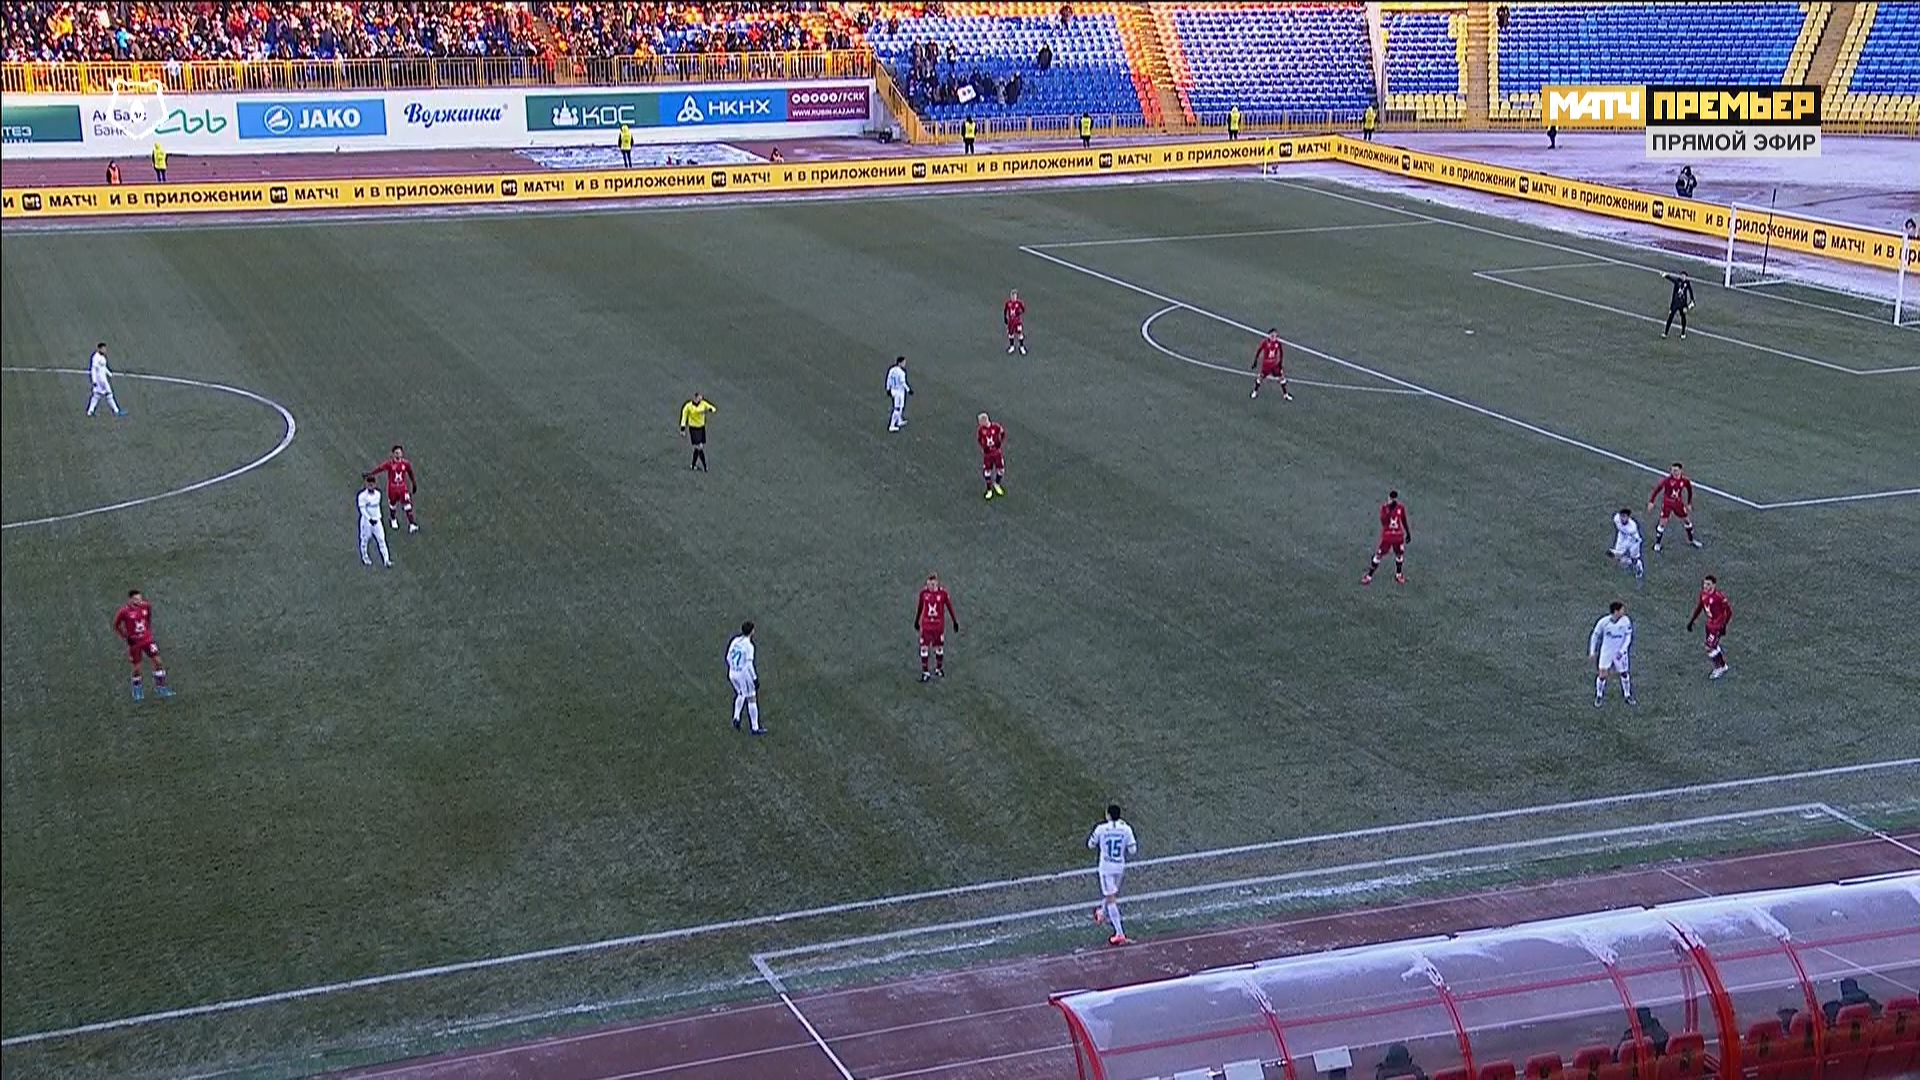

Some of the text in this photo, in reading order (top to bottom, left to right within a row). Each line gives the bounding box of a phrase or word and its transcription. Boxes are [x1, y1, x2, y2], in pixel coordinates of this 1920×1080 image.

[404, 103, 501, 128] Волжанка
[582, 105, 636, 125] КОС
[708, 99, 771, 117] НКНХ
[298, 109, 361, 129] JAKO
[49, 195, 97, 207] МАТЧ!
[110, 194, 120, 205] и
[127, 193, 138, 204] в
[144, 190, 262, 207] приложении
[295, 187, 339, 199] МАТЧ!
[354, 187, 365, 198] и
[371, 187, 380, 198] в
[386, 183, 495, 203] приложении
[523, 180, 564, 192] МАТЧ!
[575, 180, 584, 191] и
[590, 179, 599, 190] в
[605, 174, 704, 193] приложении
[733, 172, 771, 184] МАТЧ!
[784, 171, 792, 181] и
[798, 171, 806, 180] в
[812, 166, 906, 182] приложении
[932, 163, 968, 175] МАТЧ!
[977, 162, 986, 172] и
[990, 161, 998, 171] в
[1003, 157, 1093, 175] приложении
[1118, 153, 1152, 165] МАТЧ!
[1163, 153, 1172, 163] и
[1176, 152, 1184, 162] в
[1297, 142, 1331, 154] МАТЧ!
[1350, 146, 1399, 166] приложении
[1413, 160, 1435, 173] МАТЧ!
[1441, 165, 1447, 175] и
[1449, 167, 1455, 176] в
[1457, 167, 1516, 189] приложении
[1532, 180, 1557, 196] МАТЧ!
[1562, 187, 1569, 197] и
[1571, 188, 1577, 199] в
[1580, 189, 1648, 212] приложении
[1668, 205, 1696, 222] МАТЧ!
[1705, 213, 1713, 225] и
[1716, 215, 1723, 227] в
[1831, 234, 1865, 253] МАТЧ!
[1874, 242, 1882, 256] и
[1886, 245, 1895, 258] в
[1105, 838, 1122, 858] 15
